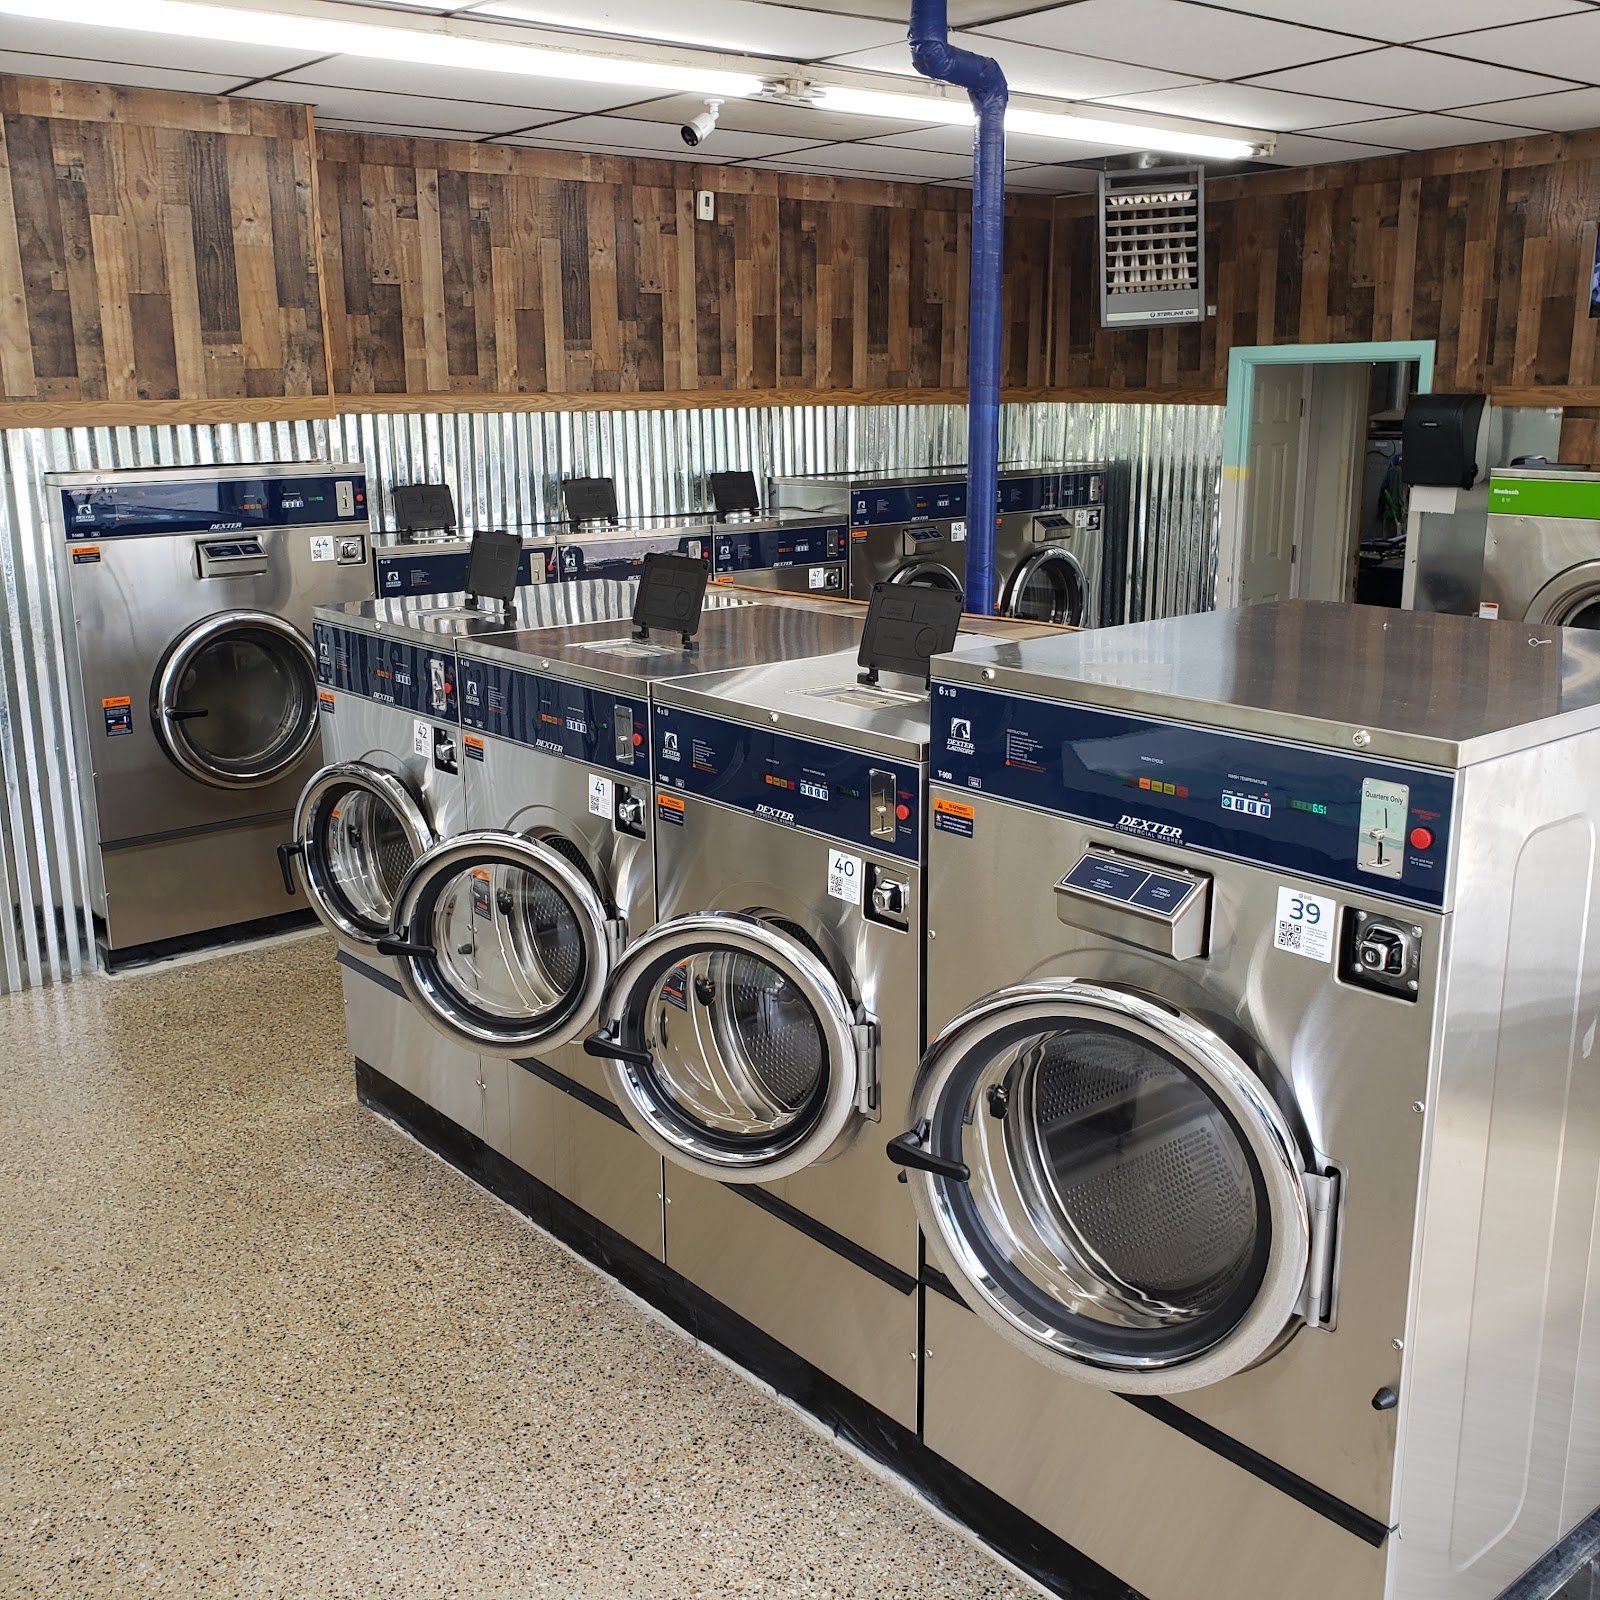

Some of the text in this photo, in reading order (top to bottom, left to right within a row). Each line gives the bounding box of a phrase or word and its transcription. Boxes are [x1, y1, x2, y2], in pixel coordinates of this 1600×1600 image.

[373, 692, 394, 703] DEXTER
[939, 686, 943, 695] 6
[418, 726, 427, 738] 42
[536, 739, 563, 753] DEXTER
[946, 745, 975, 755] LAUNDRY
[947, 738, 974, 749] DEXTER
[1240, 776, 1268, 785] TEMPERATURE
[595, 781, 605, 796] 41
[1365, 790, 1403, 805] Quarters Only
[756, 804, 794, 821] DEXTER
[1118, 815, 1182, 838] DEXTER
[1116, 824, 1183, 845] COMMERCIAL WASHER
[835, 858, 854, 877] 40
[1289, 898, 1320, 924] 39
